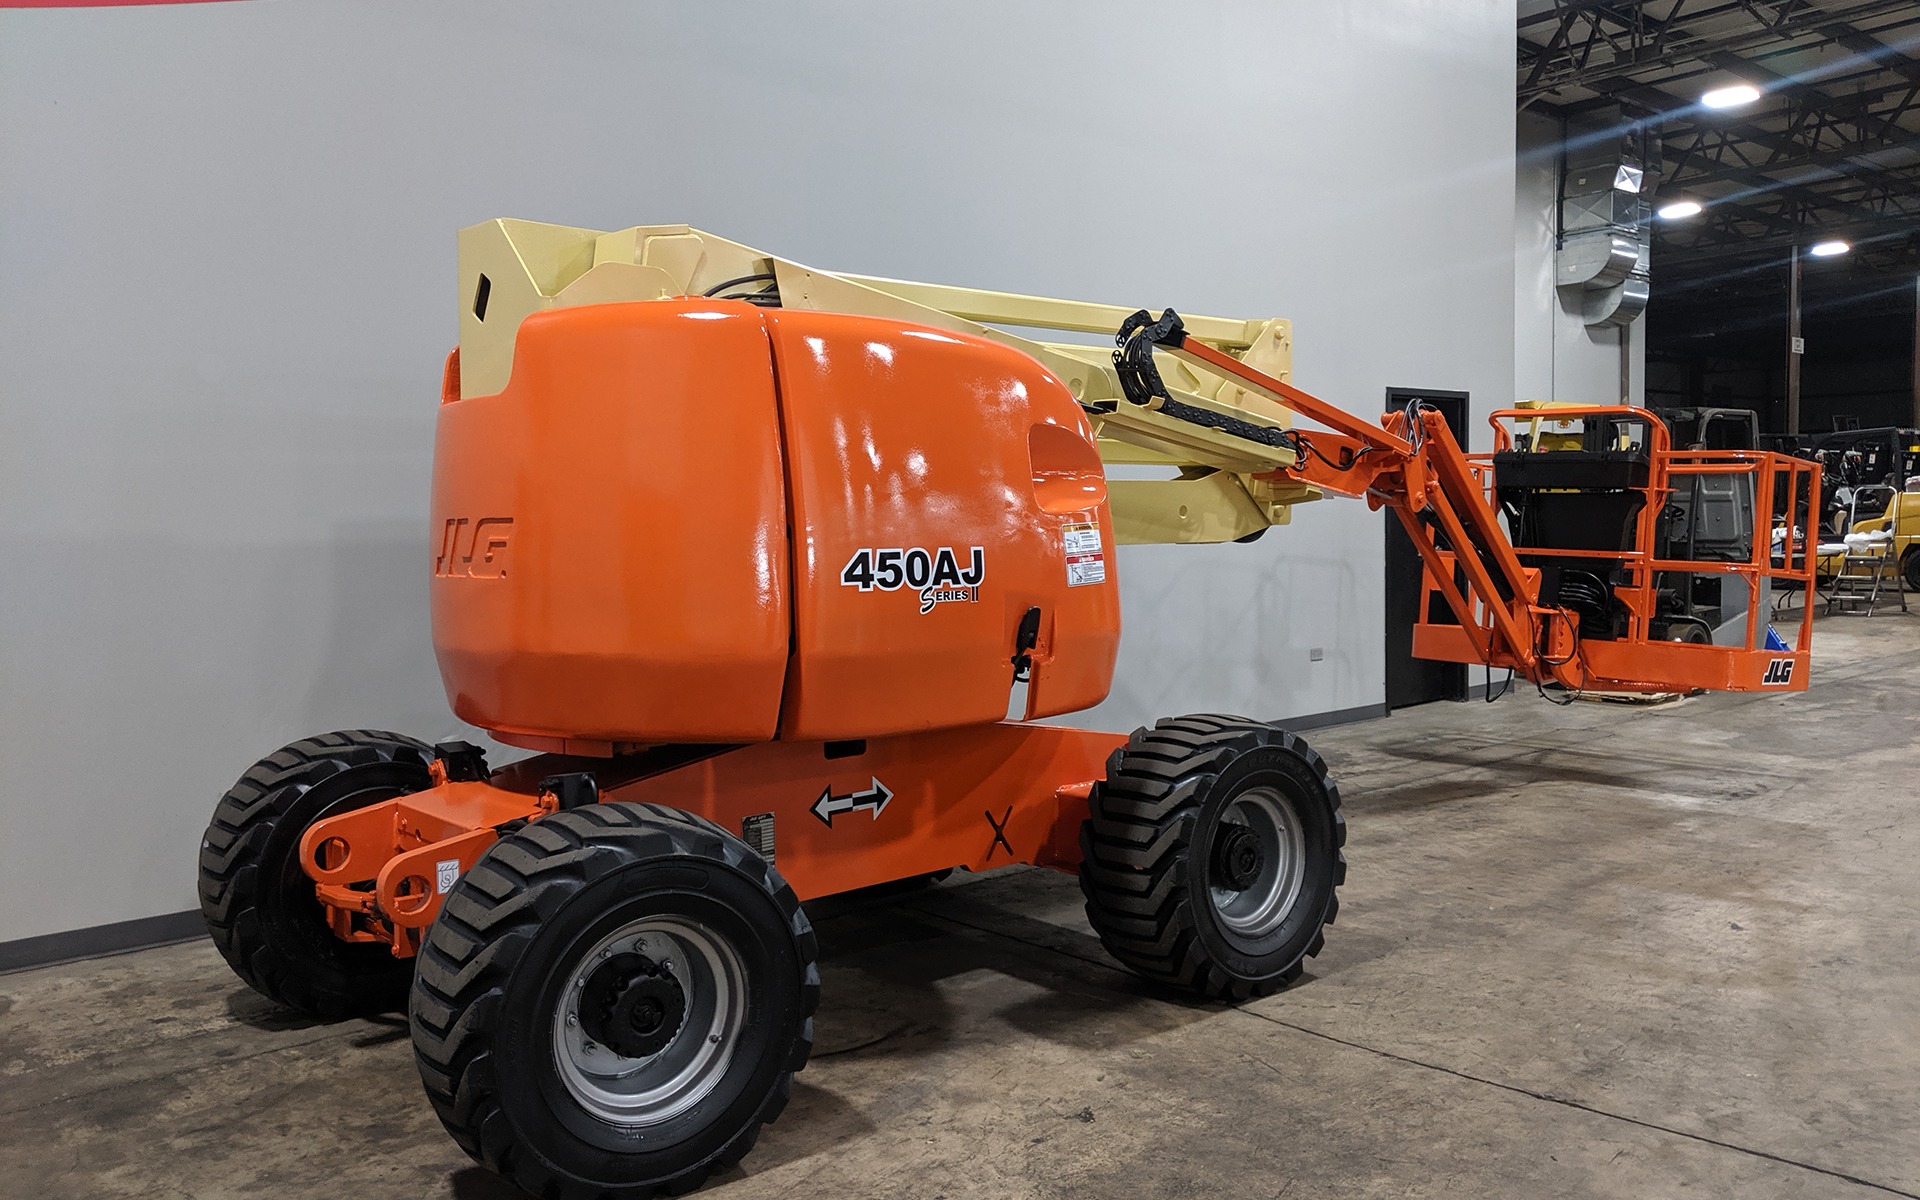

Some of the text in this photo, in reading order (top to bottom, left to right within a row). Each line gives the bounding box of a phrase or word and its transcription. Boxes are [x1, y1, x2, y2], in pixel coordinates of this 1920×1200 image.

[436, 517, 514, 579] JLG
[842, 547, 985, 591] 450AJ
[1763, 660, 1795, 684] JLG
